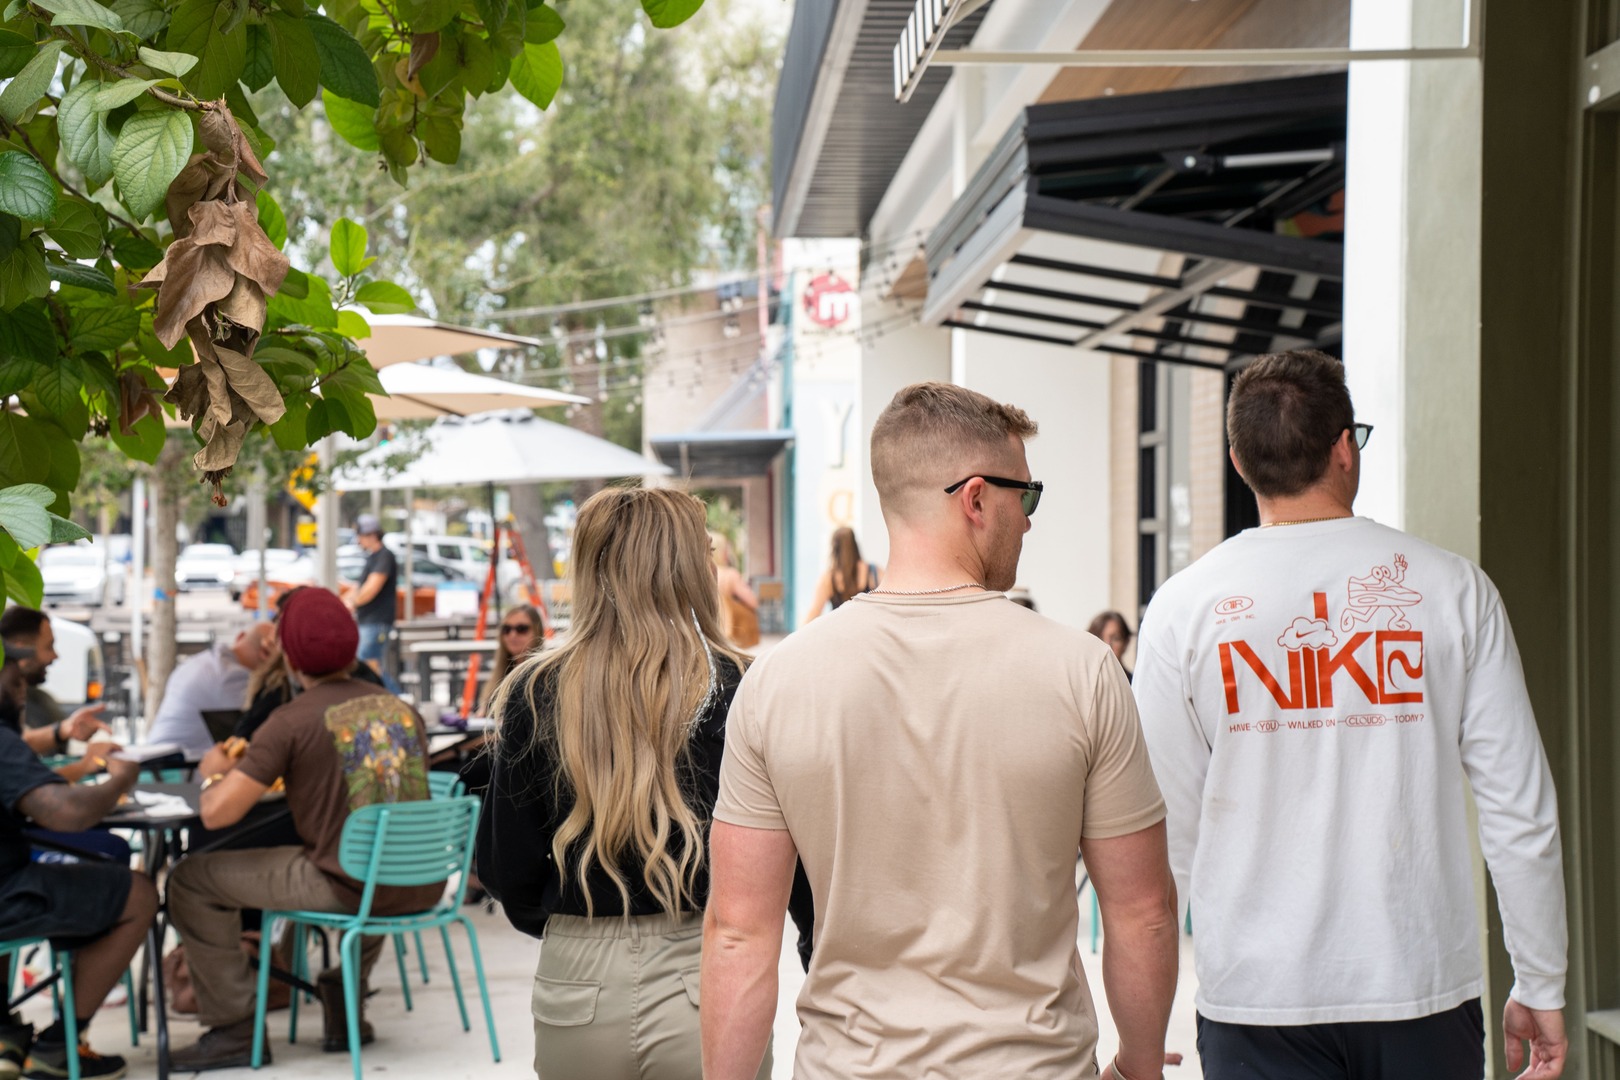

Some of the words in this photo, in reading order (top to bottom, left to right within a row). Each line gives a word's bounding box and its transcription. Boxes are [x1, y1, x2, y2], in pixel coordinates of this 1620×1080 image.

[1218, 592, 1423, 715] NIKE
[1229, 723, 1251, 733] HAVE
[1259, 721, 1277, 731] YOU
[1287, 720, 1323, 729] WALKED
[1325, 719, 1336, 727] ON
[1348, 716, 1384, 726] CLOUDS
